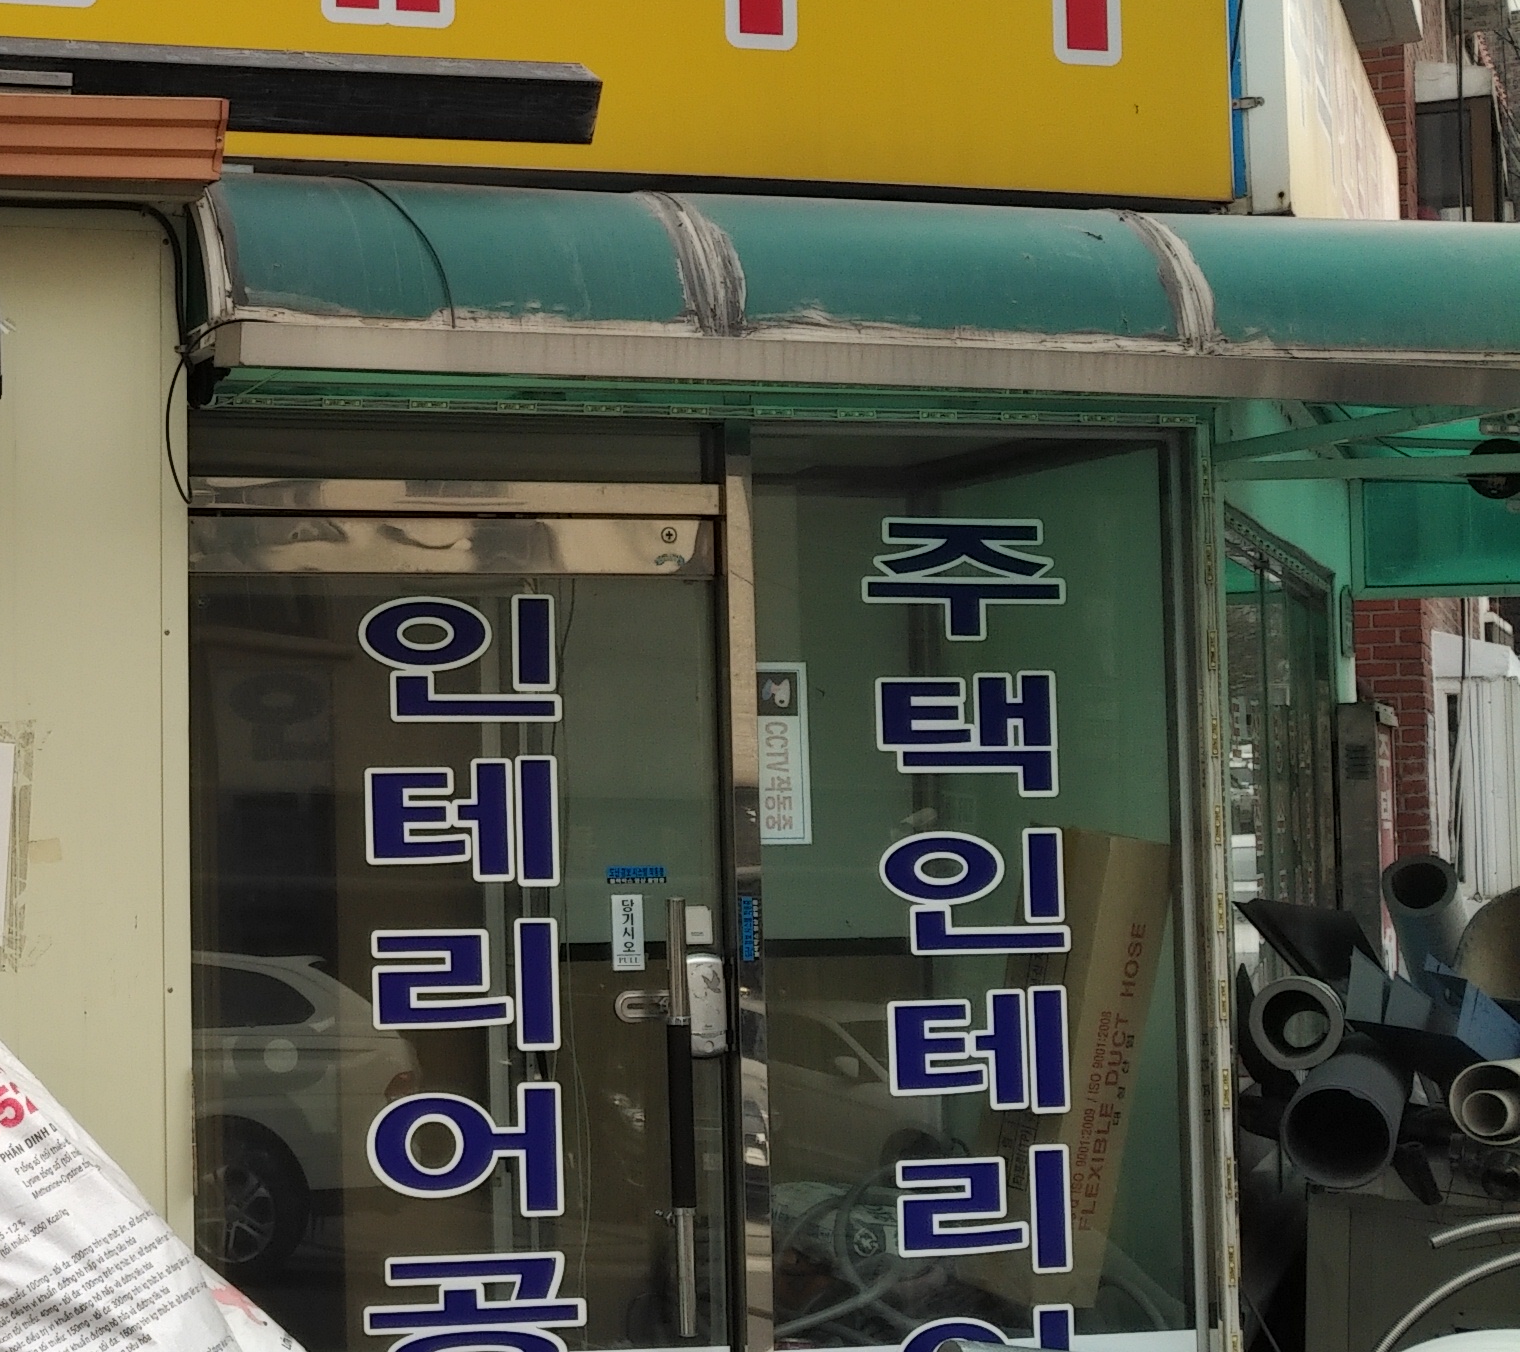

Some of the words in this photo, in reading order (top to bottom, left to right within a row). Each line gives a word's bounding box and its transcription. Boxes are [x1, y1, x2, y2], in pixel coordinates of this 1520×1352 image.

[622, 899, 635, 953] 당기시오
[1078, 1102, 1115, 1231] FLEXIBLE
[1105, 1012, 1129, 1088] DUCT
[1120, 922, 1147, 998] HOSE
